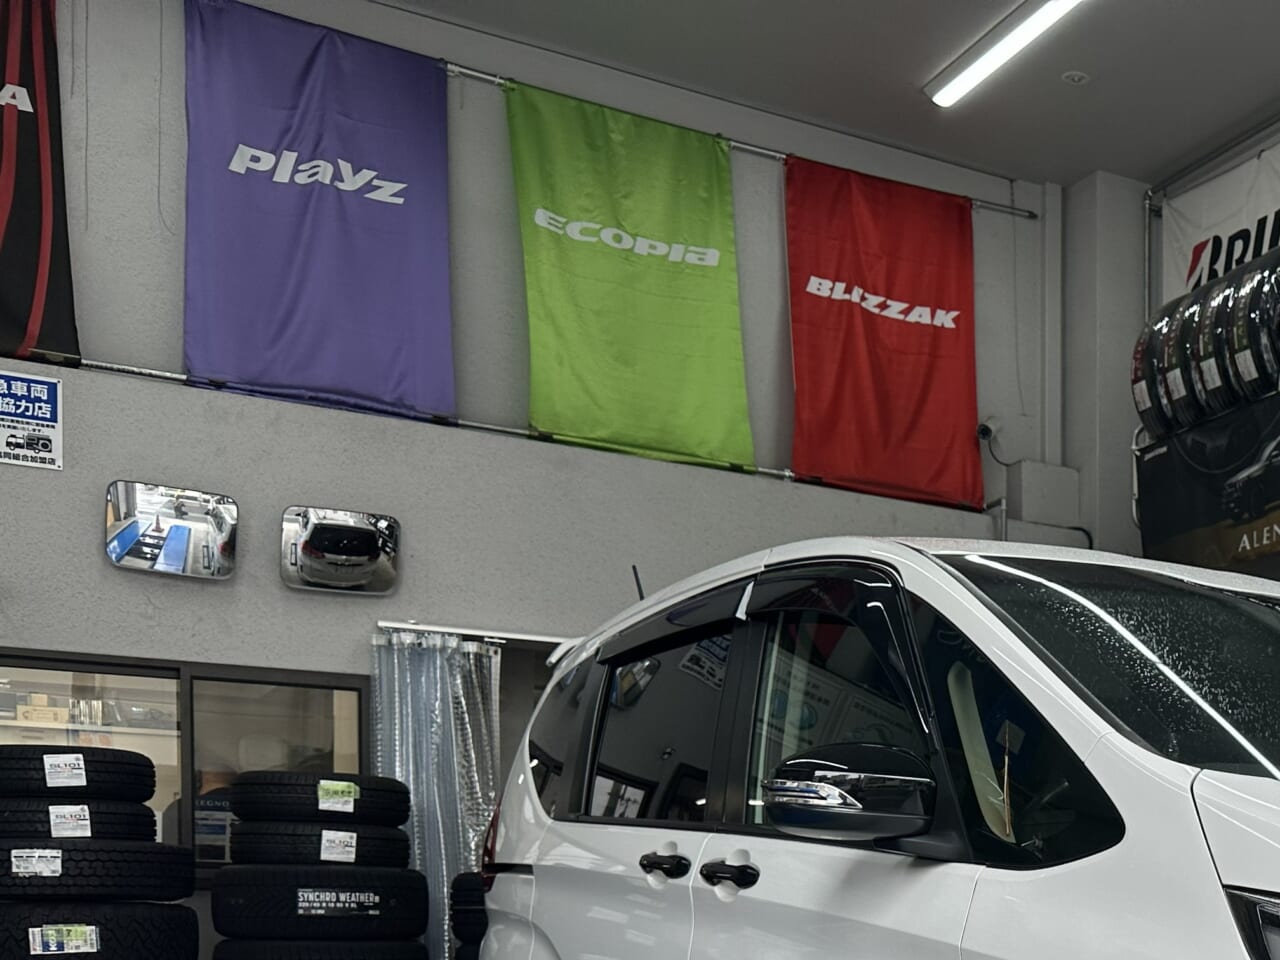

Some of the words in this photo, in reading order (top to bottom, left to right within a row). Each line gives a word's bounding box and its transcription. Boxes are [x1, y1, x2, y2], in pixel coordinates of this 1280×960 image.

[805, 275, 961, 329] BLIZZAK
[298, 892, 337, 902] SYNCHRO
[338, 892, 374, 902] WEATHER
